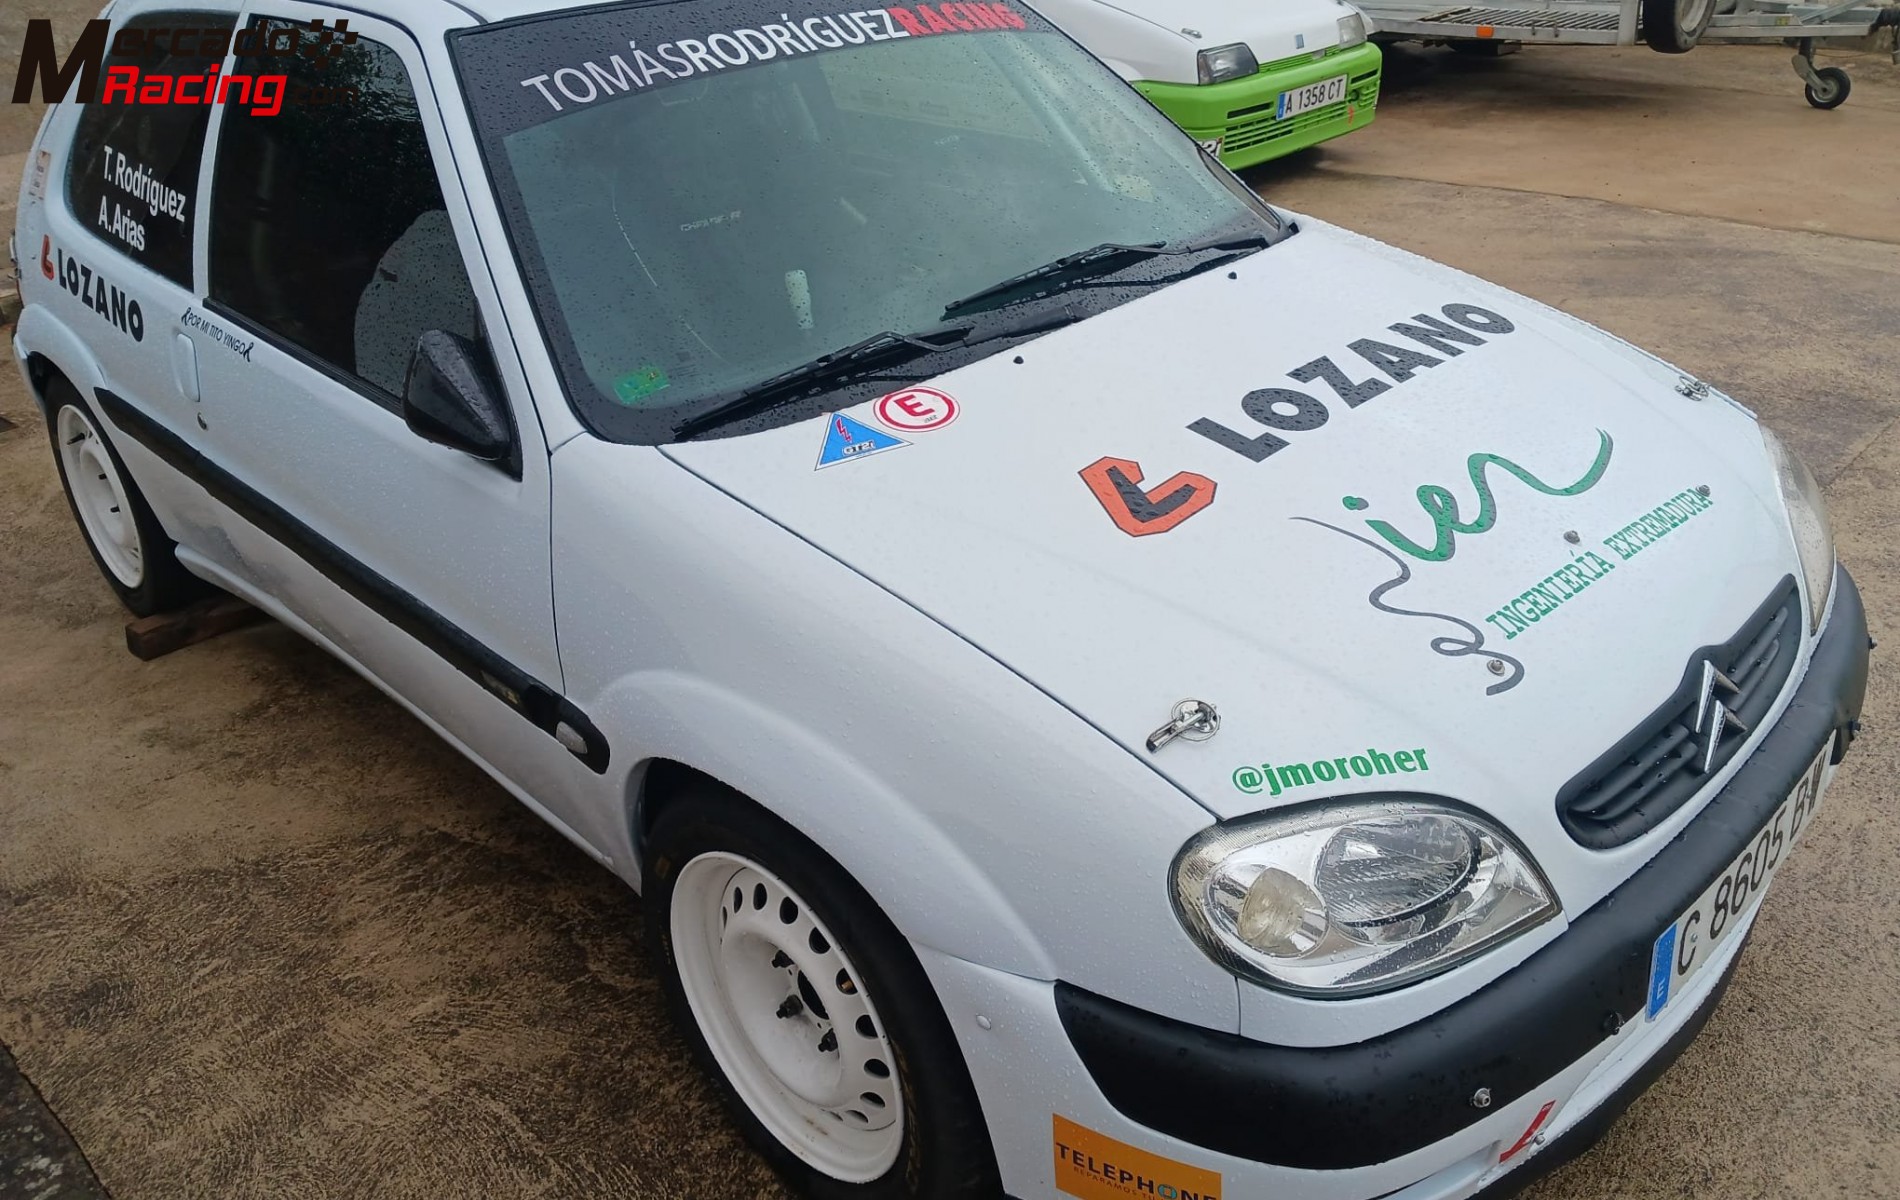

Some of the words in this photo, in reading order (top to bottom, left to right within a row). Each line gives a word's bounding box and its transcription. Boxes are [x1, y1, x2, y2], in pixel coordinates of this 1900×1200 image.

[1286, 94, 1293, 114] A
[1299, 84, 1326, 110] 1358
[1328, 79, 1344, 101] CT
[104, 145, 113, 182] T.
[115, 152, 186, 222] Rodríguez
[58, 248, 144, 342] LOZANO
[188, 313, 201, 329] POR
[200, 320, 210, 334] MI
[209, 325, 223, 342] TITO
[223, 333, 246, 354] YINGO
[894, 394, 935, 417] E
[1186, 303, 1515, 462] LOZANO
[1486, 549, 1615, 640] INGENIERÍA
[1603, 488, 1713, 561] EXTREMADURA
[1232, 748, 1431, 796] @jmoroher
[1677, 910, 1700, 976] C
[1710, 805, 1787, 940] 8605
[1074, 1166, 1137, 1196] REPARAMOS
